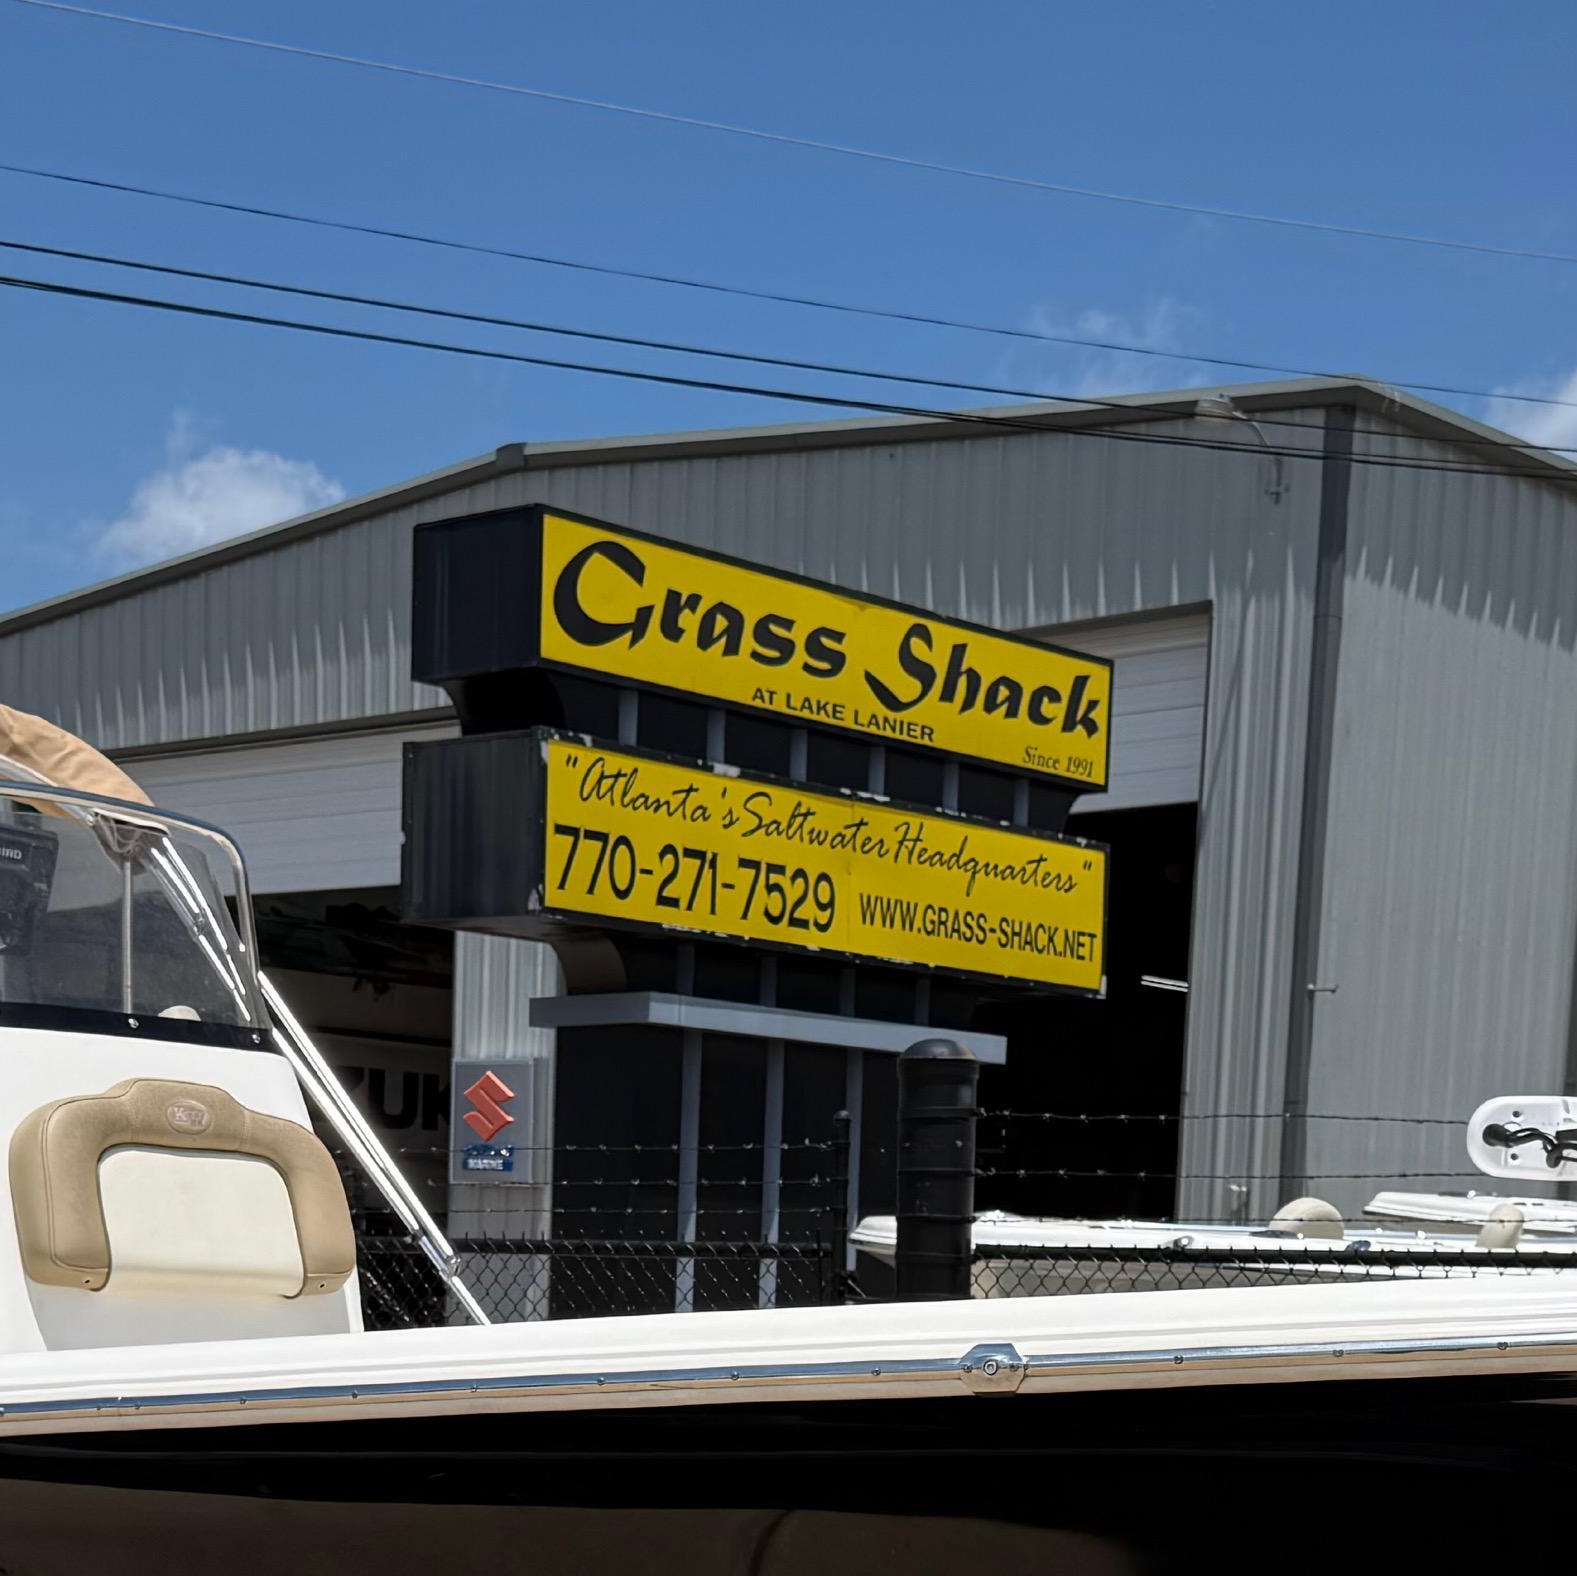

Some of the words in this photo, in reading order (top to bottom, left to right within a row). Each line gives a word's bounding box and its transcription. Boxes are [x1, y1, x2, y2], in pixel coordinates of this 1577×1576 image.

[553, 541, 847, 679] Grass
[864, 623, 1100, 738] Shack
[752, 687, 777, 706] AT
[786, 693, 845, 721] LAKE
[854, 709, 934, 742] LANIER
[1023, 746, 1061, 770] Since
[1065, 756, 1094, 778] 1991
[741, 791, 890, 860] Saltwater
[553, 822, 836, 934] 770-271-7529
[858, 892, 1098, 963] WWW.GRASS-SHACK.NET
